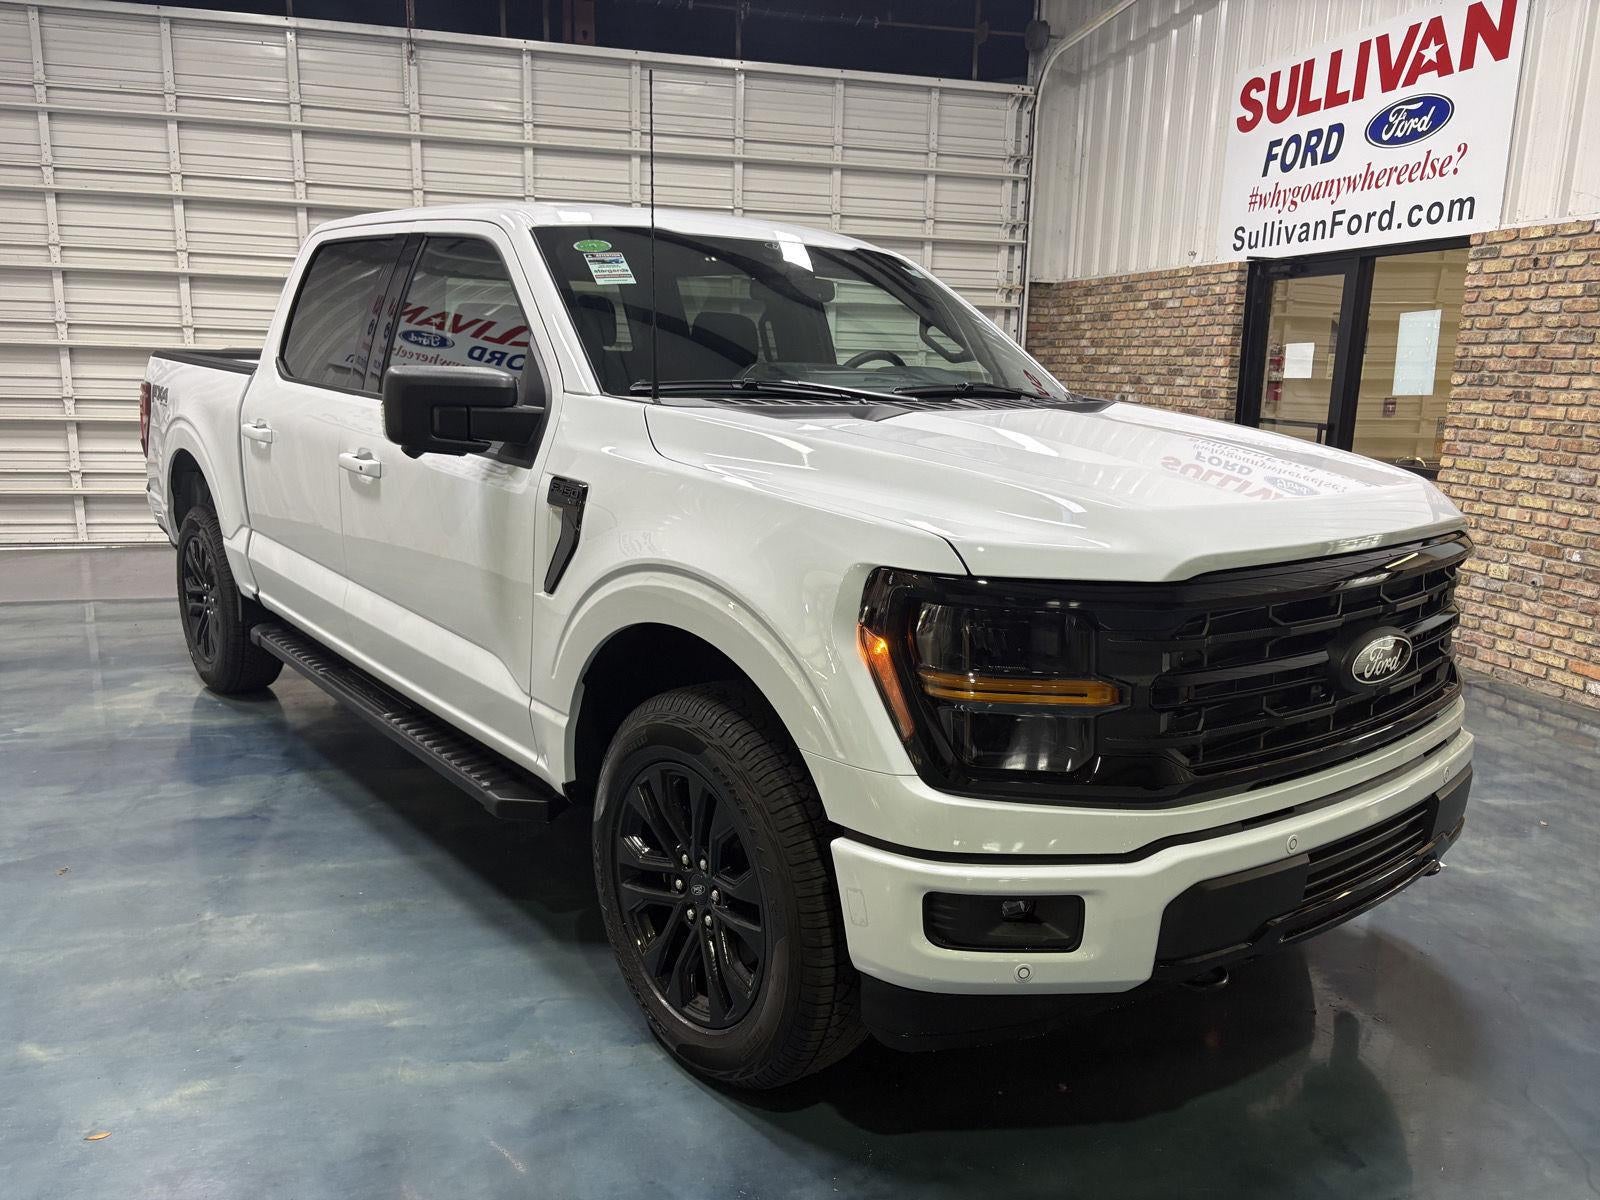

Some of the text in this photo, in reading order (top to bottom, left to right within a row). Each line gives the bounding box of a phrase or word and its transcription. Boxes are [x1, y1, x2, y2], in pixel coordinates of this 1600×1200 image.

[1236, 0, 1518, 133] SULLIVAN
[1382, 101, 1435, 142] Ford
[1247, 142, 1468, 214] #whygoanywhereelse?
[1261, 122, 1345, 178] FORD
[1232, 195, 1475, 252] SullivanFord.com
[1364, 643, 1403, 678] Ford
